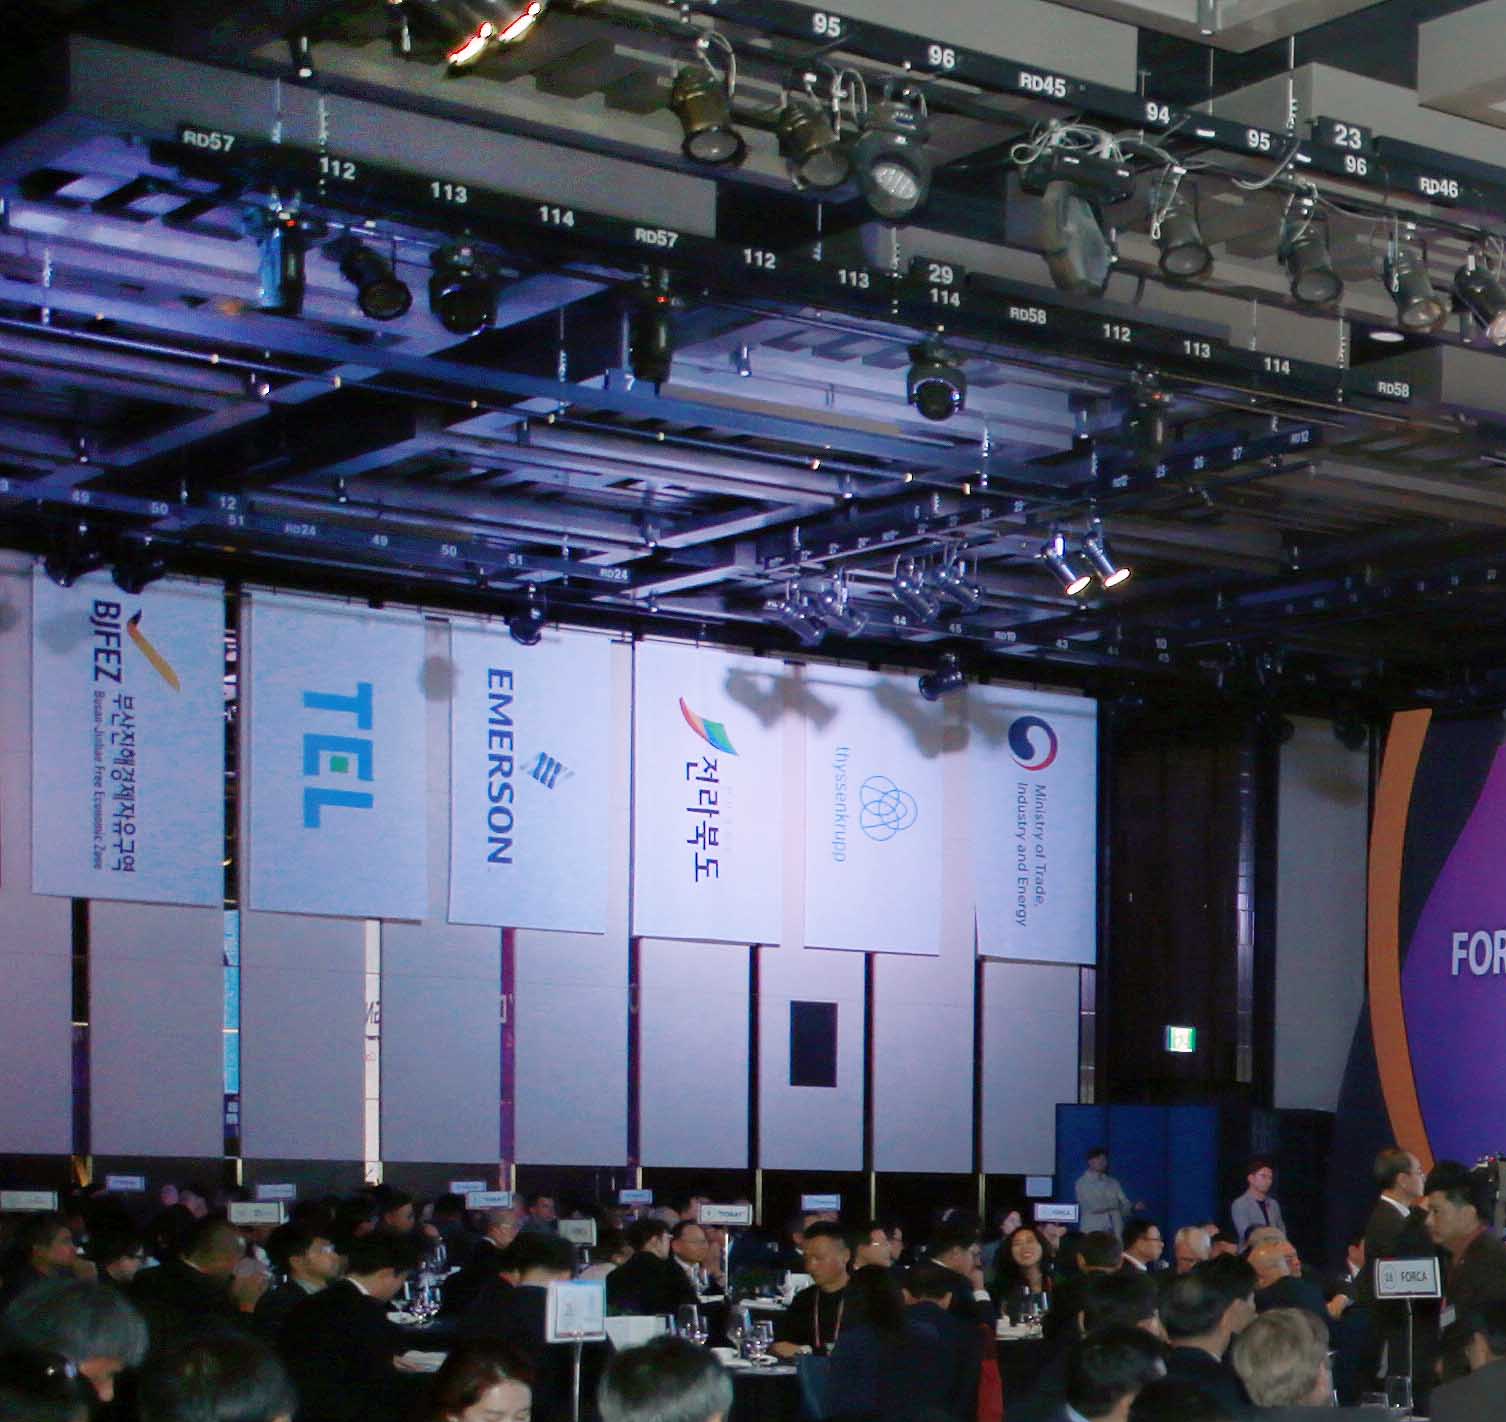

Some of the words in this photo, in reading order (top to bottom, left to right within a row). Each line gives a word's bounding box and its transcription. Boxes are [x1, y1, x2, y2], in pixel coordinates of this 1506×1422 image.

[812, 13, 841, 38] 95
[928, 45, 955, 69] 96
[1019, 71, 1066, 98] RD45
[1145, 102, 1170, 125] 94
[182, 129, 235, 153] RD57
[1247, 128, 1271, 152] 95
[1334, 123, 1362, 150] 23
[319, 157, 356, 181] 112
[1344, 155, 1367, 176] 96
[430, 181, 467, 204] 113
[1419, 176, 1459, 199] RD46
[539, 205, 574, 228] 114
[635, 227, 679, 247] RD57
[743, 248, 777, 270] 112
[838, 269, 870, 289] 113
[928, 263, 954, 284] 29
[929, 288, 960, 307] 114
[1009, 306, 1047, 325] RD58
[1102, 324, 1131, 343] 112
[1183, 340, 1211, 359] 113
[1264, 357, 1291, 376] 114
[1378, 381, 1410, 398] RD58
[91, 599, 124, 685] BJFEZ
[304, 681, 374, 828] TEL
[487, 667, 515, 866] EMERSON
[831, 745, 851, 864] thyssenkrupp
[1016, 782, 1029, 840] Industry
[1032, 784, 1047, 840] Ministry
[686, 756, 720, 883] 전라북도
[1017, 844, 1029, 872] and
[1016, 876, 1029, 927] Energy
